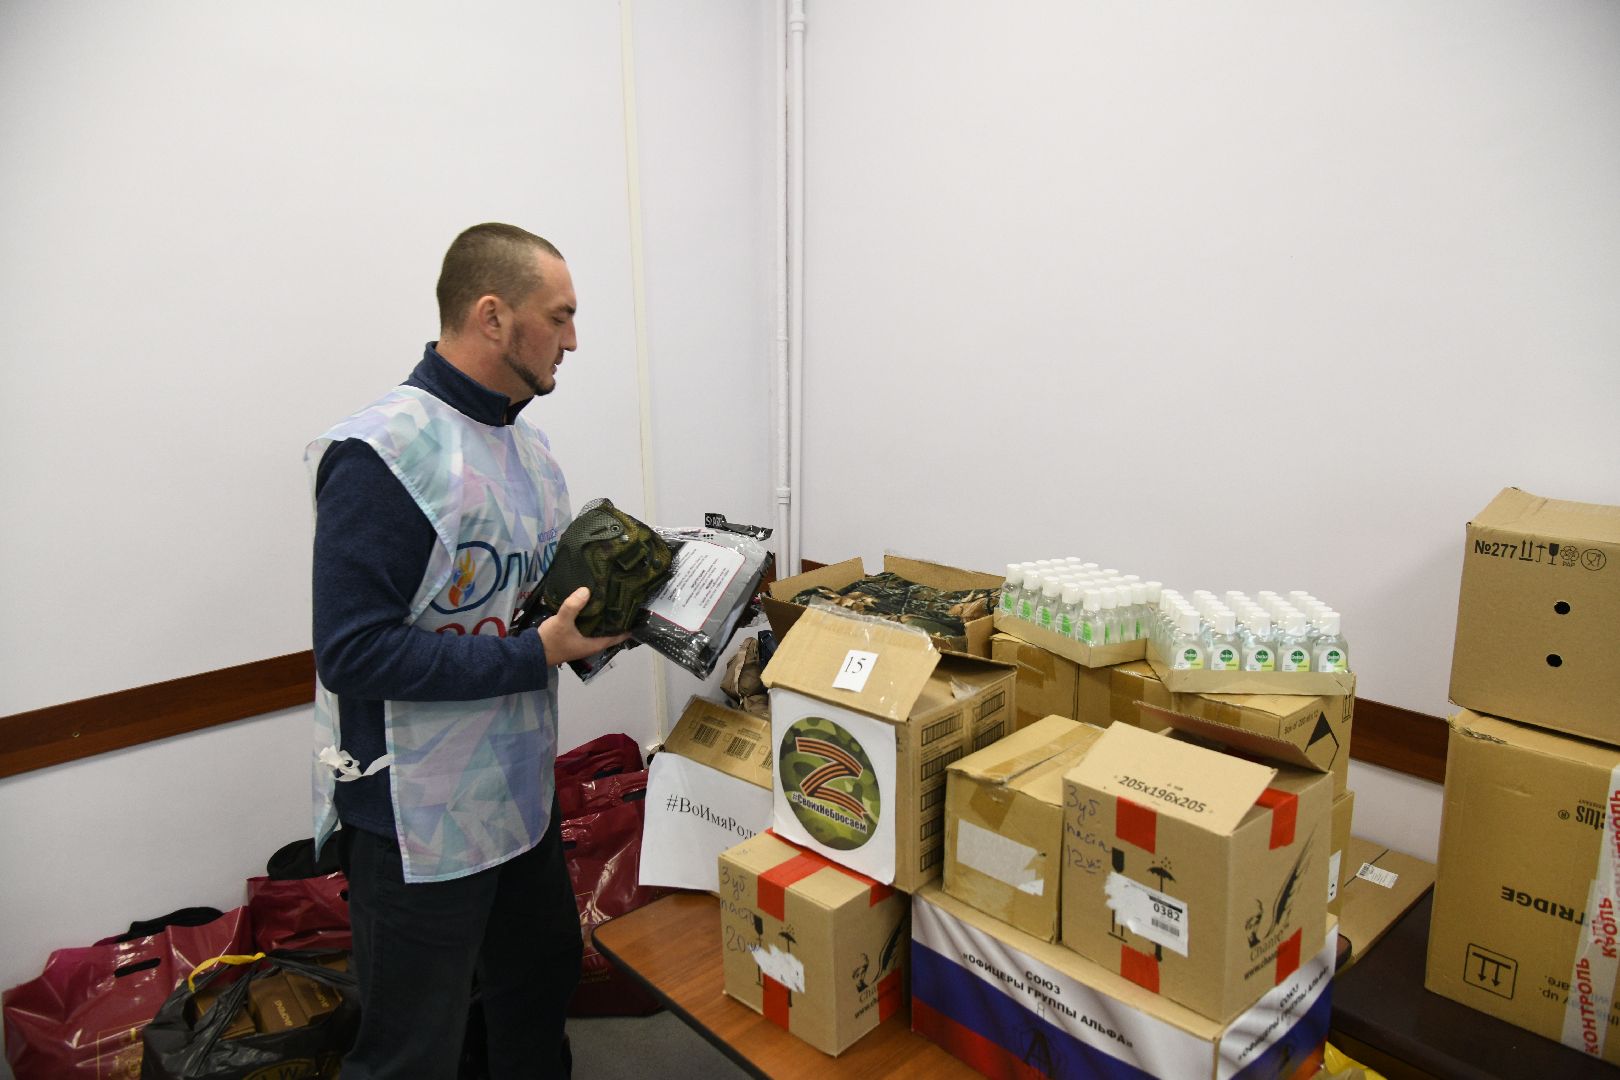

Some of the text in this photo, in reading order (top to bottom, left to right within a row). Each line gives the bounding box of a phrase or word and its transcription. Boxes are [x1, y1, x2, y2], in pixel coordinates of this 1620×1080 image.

[1474, 539, 1518, 559] №277
[844, 656, 866, 674] 15
[1118, 775, 1207, 813] 205x196x205
[666, 793, 757, 840] #ВоИмяРод
[1153, 902, 1181, 922] 0382
[1025, 970, 1061, 995] СОЮЗ
[1027, 985, 1077, 1019] ГРУППЫ
